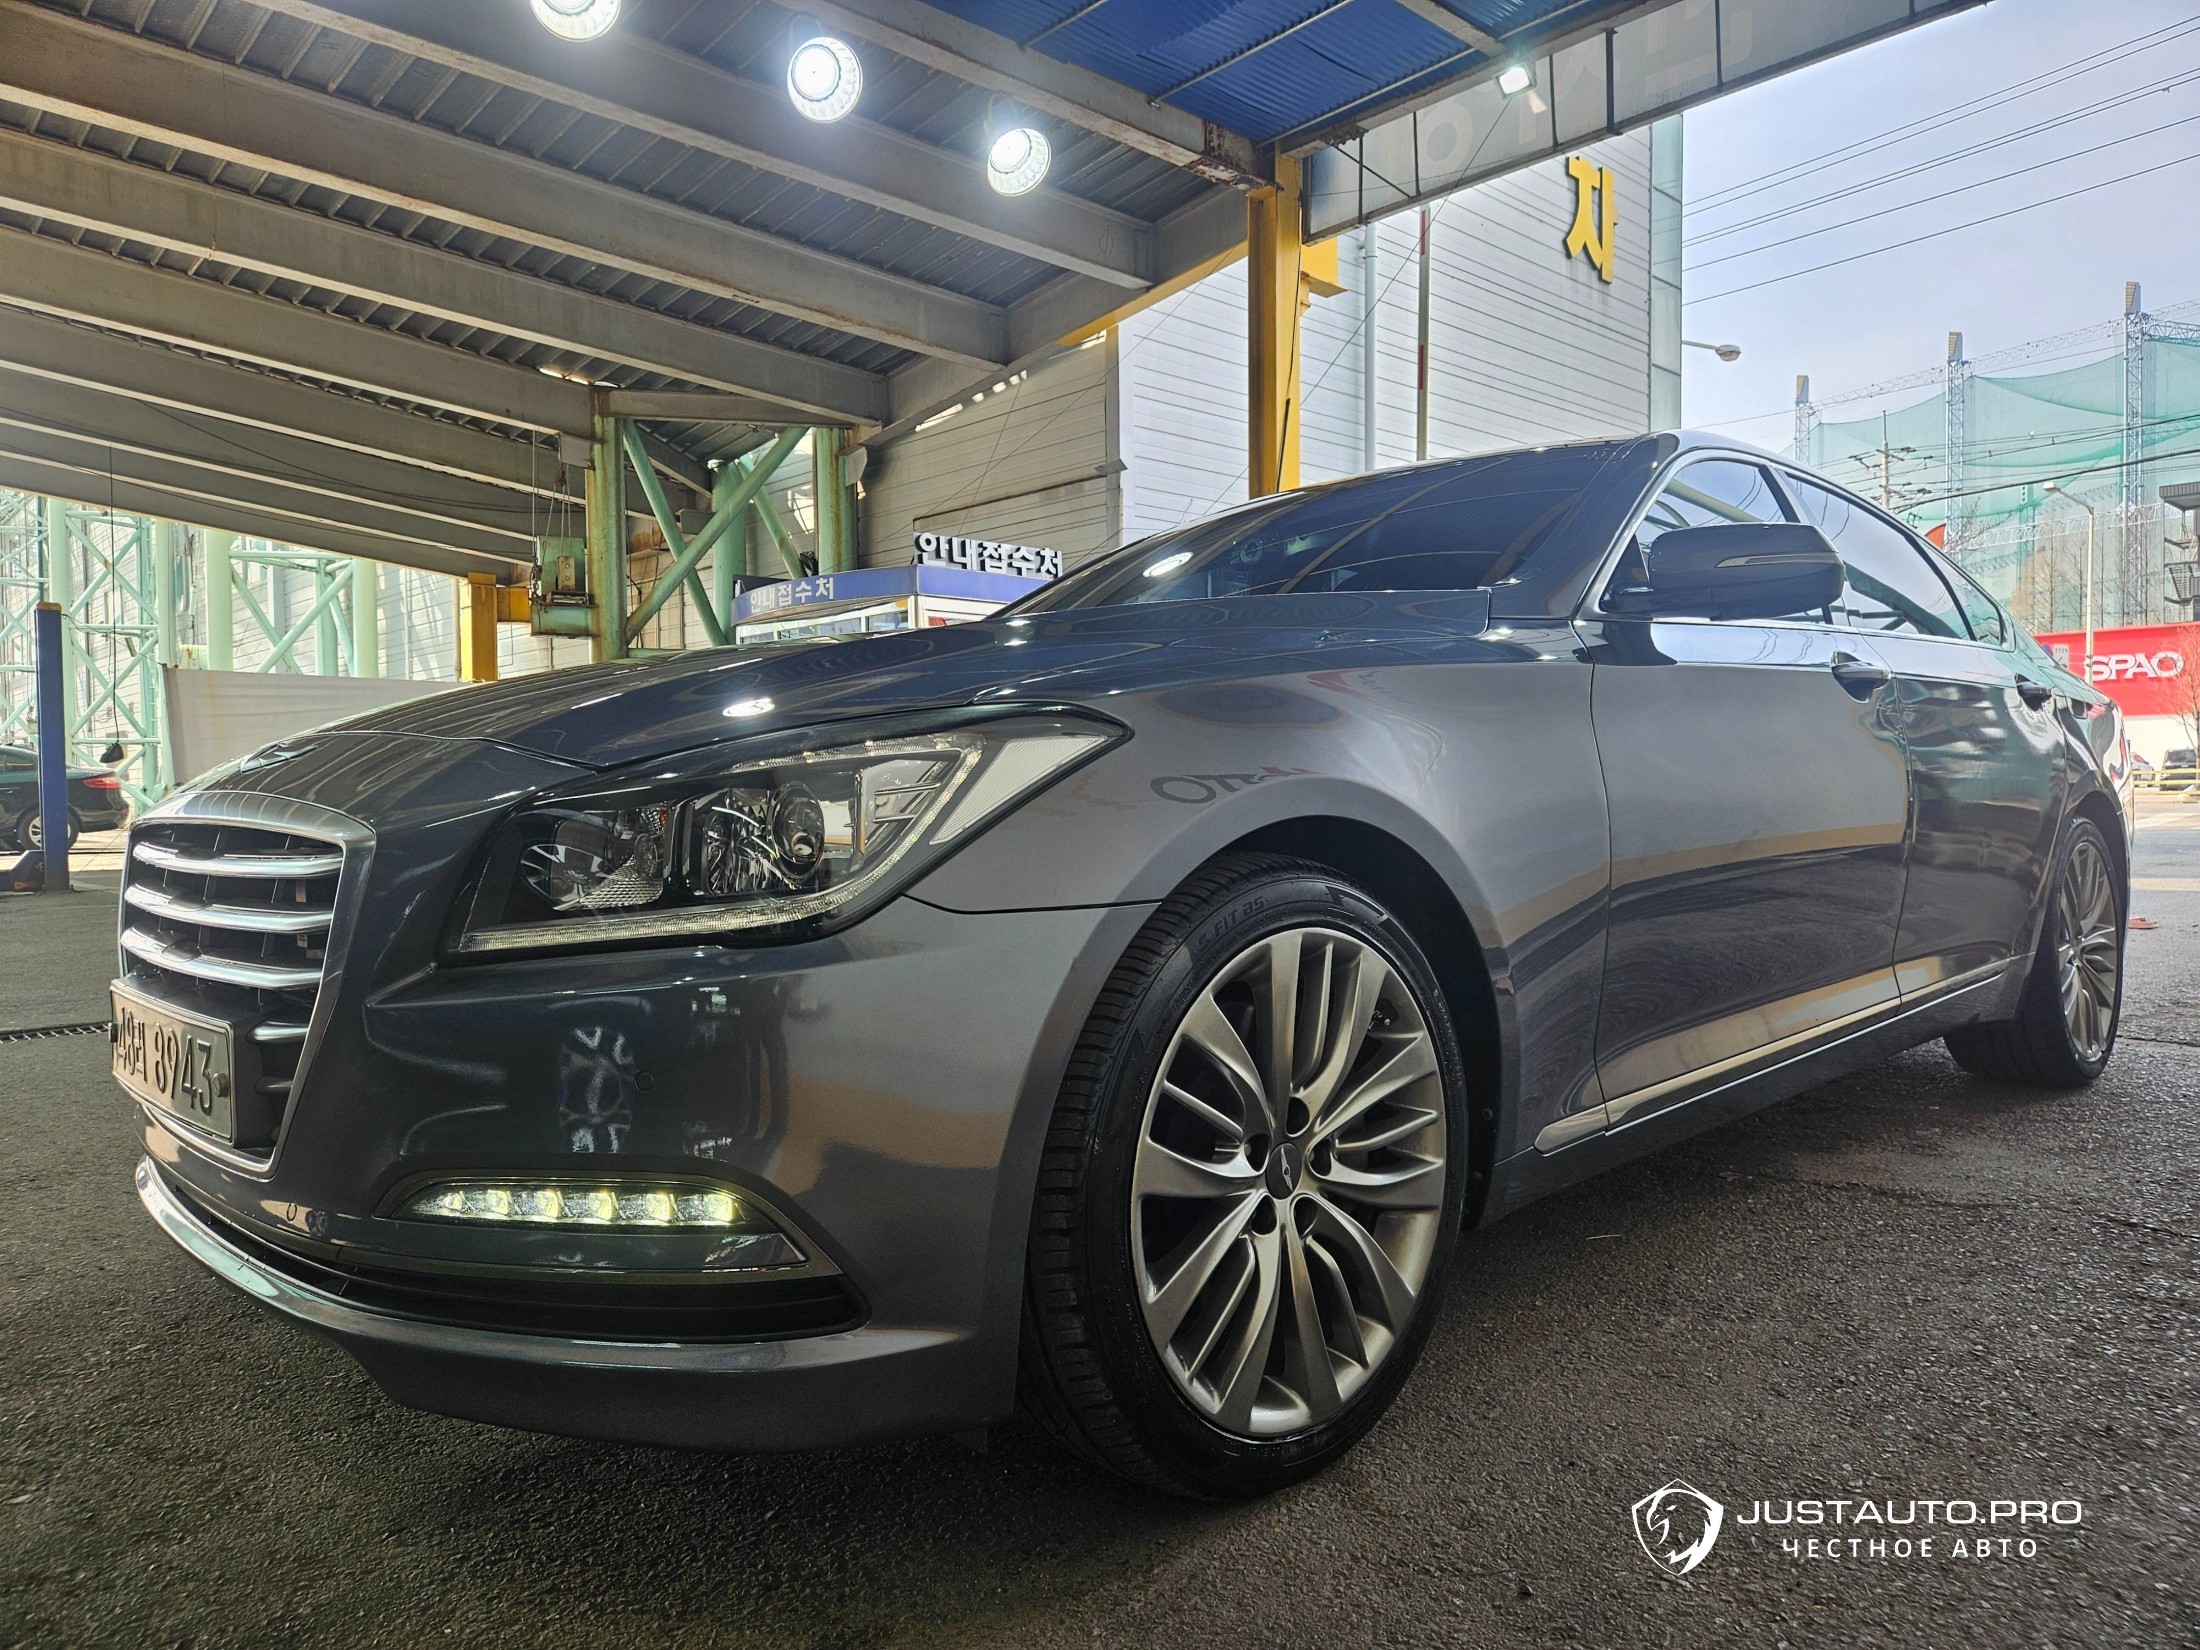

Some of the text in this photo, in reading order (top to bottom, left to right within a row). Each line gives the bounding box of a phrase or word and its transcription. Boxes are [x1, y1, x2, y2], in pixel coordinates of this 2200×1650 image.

[918, 532, 1063, 578] 안내접수처
[750, 577, 834, 613] 안내접수처
[2084, 651, 2184, 682] SPAO
[154, 1022, 212, 1117] 8943
